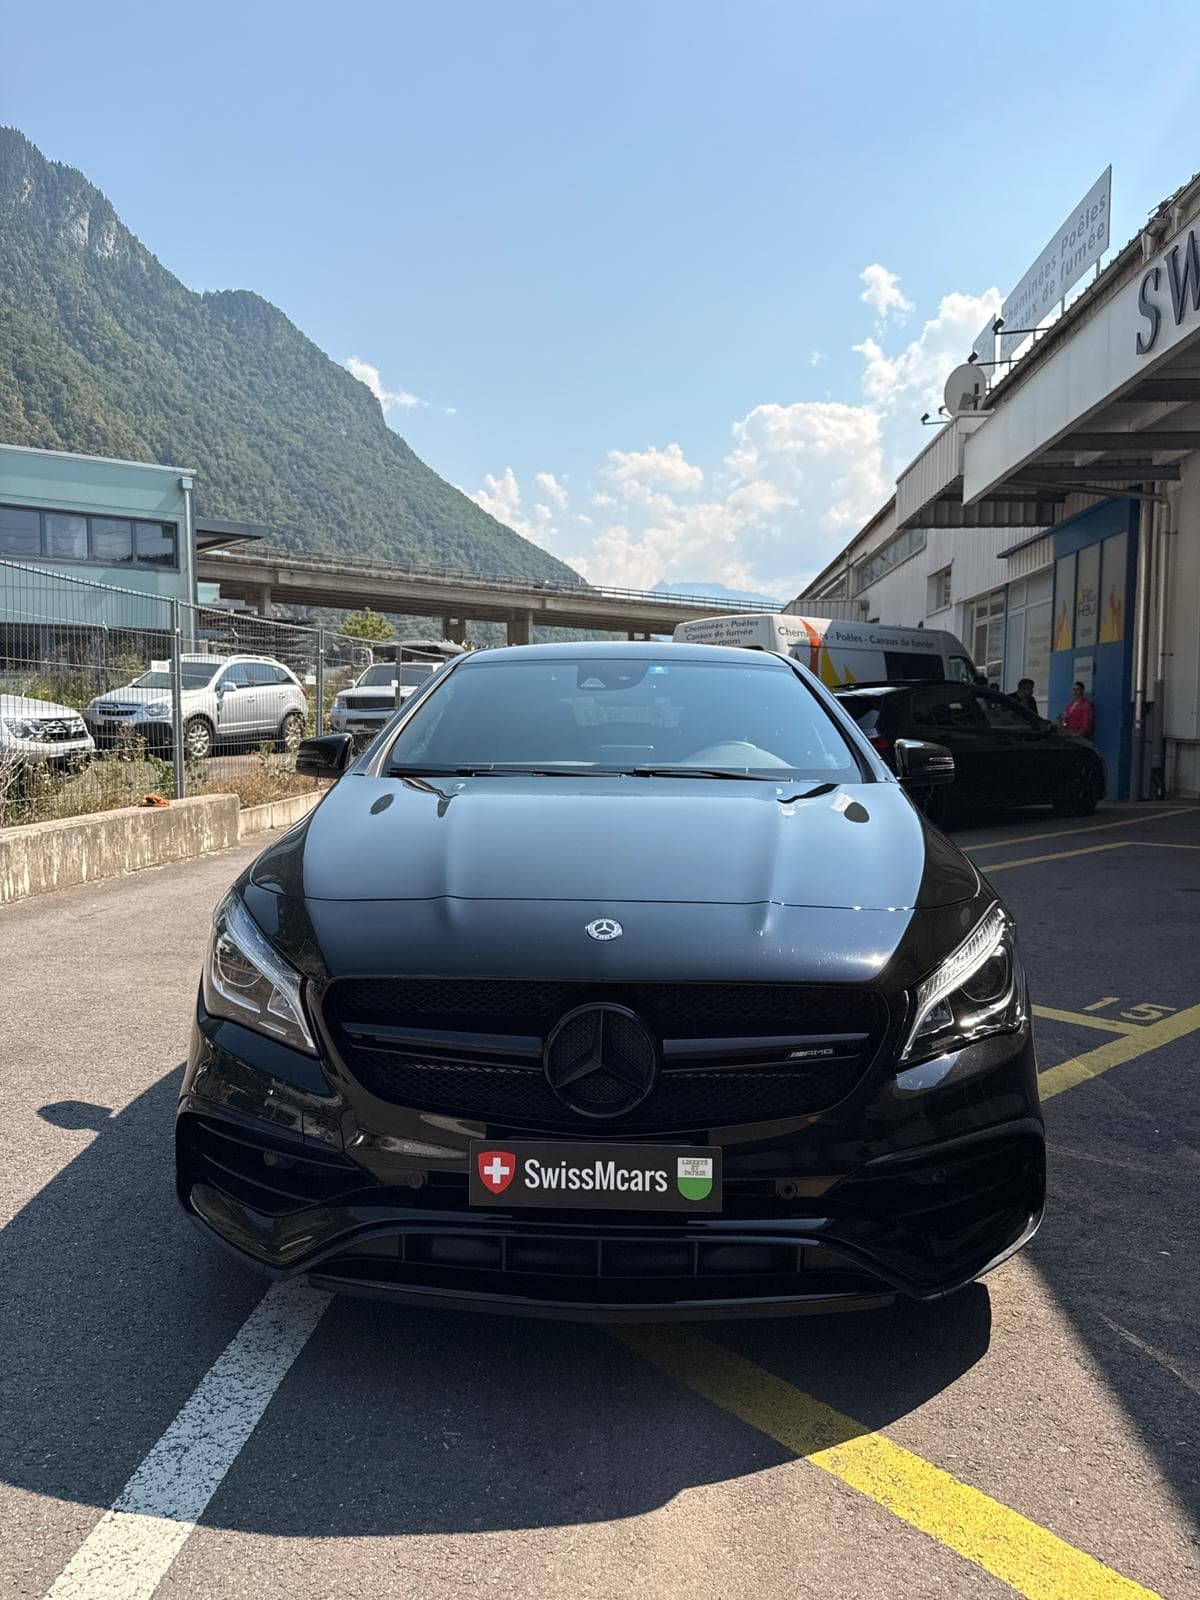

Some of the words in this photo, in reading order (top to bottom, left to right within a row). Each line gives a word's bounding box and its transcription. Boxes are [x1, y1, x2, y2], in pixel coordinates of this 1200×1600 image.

[1060, 194, 1105, 258] Poêles
[1042, 280, 1055, 303] de
[1060, 222, 1104, 282] fumée
[524, 1159, 668, 1192] SwissMcars
